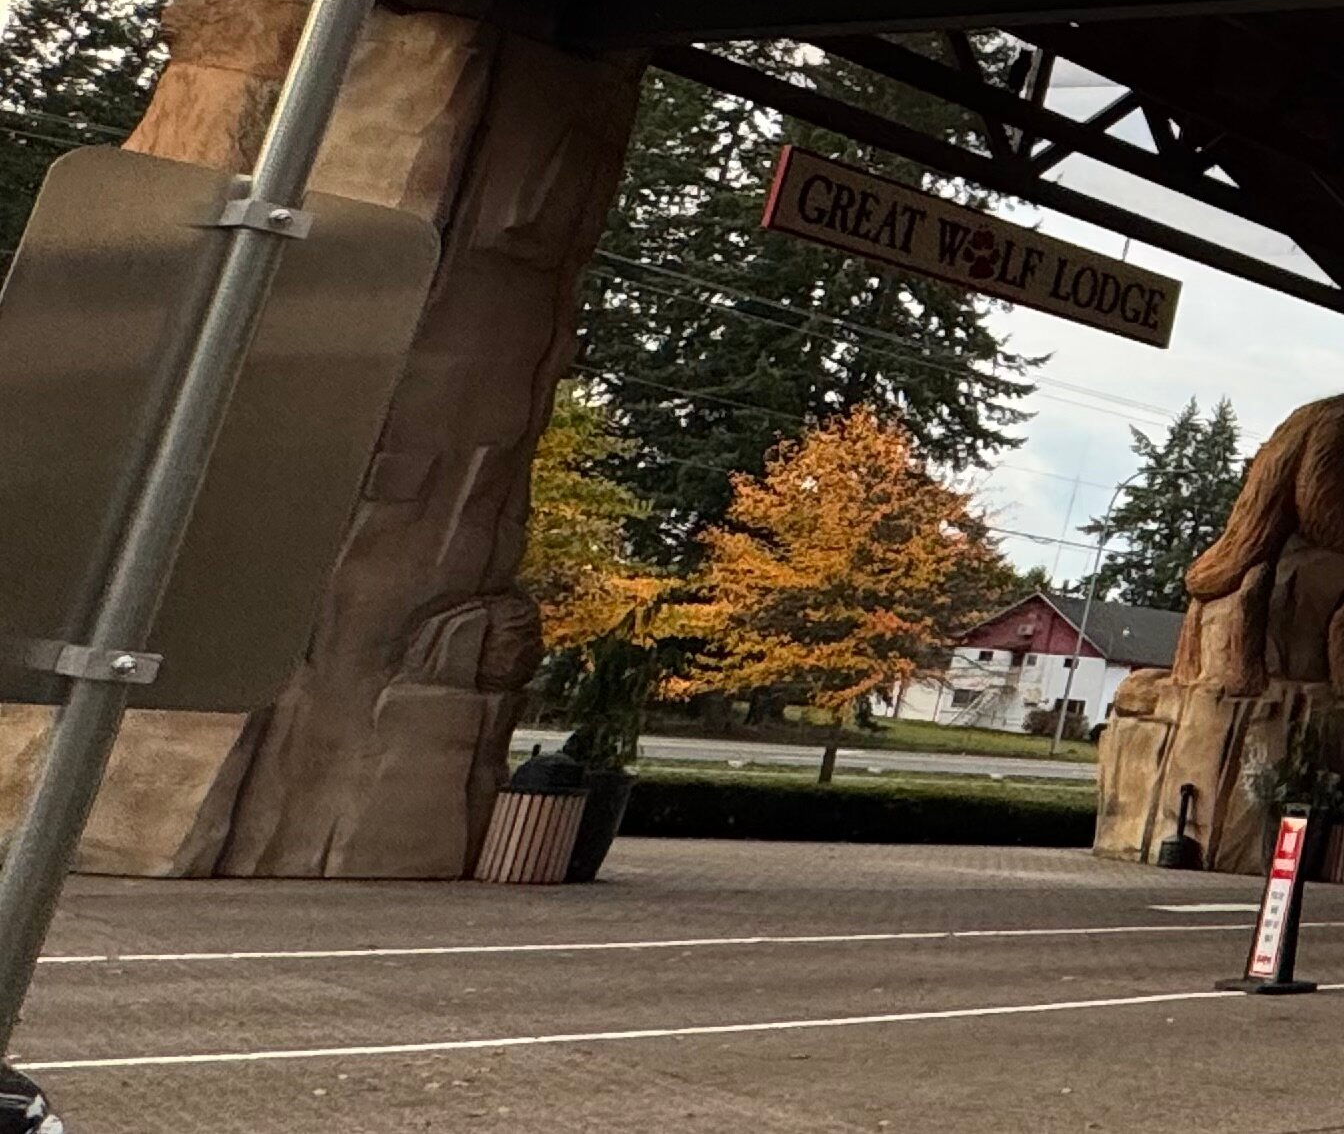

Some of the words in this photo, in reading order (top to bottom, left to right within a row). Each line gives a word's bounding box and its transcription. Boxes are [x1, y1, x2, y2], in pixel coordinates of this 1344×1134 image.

[799, 174, 926, 254] GREAT
[937, 217, 1044, 290] WLF
[1049, 257, 1166, 331] LODGE
